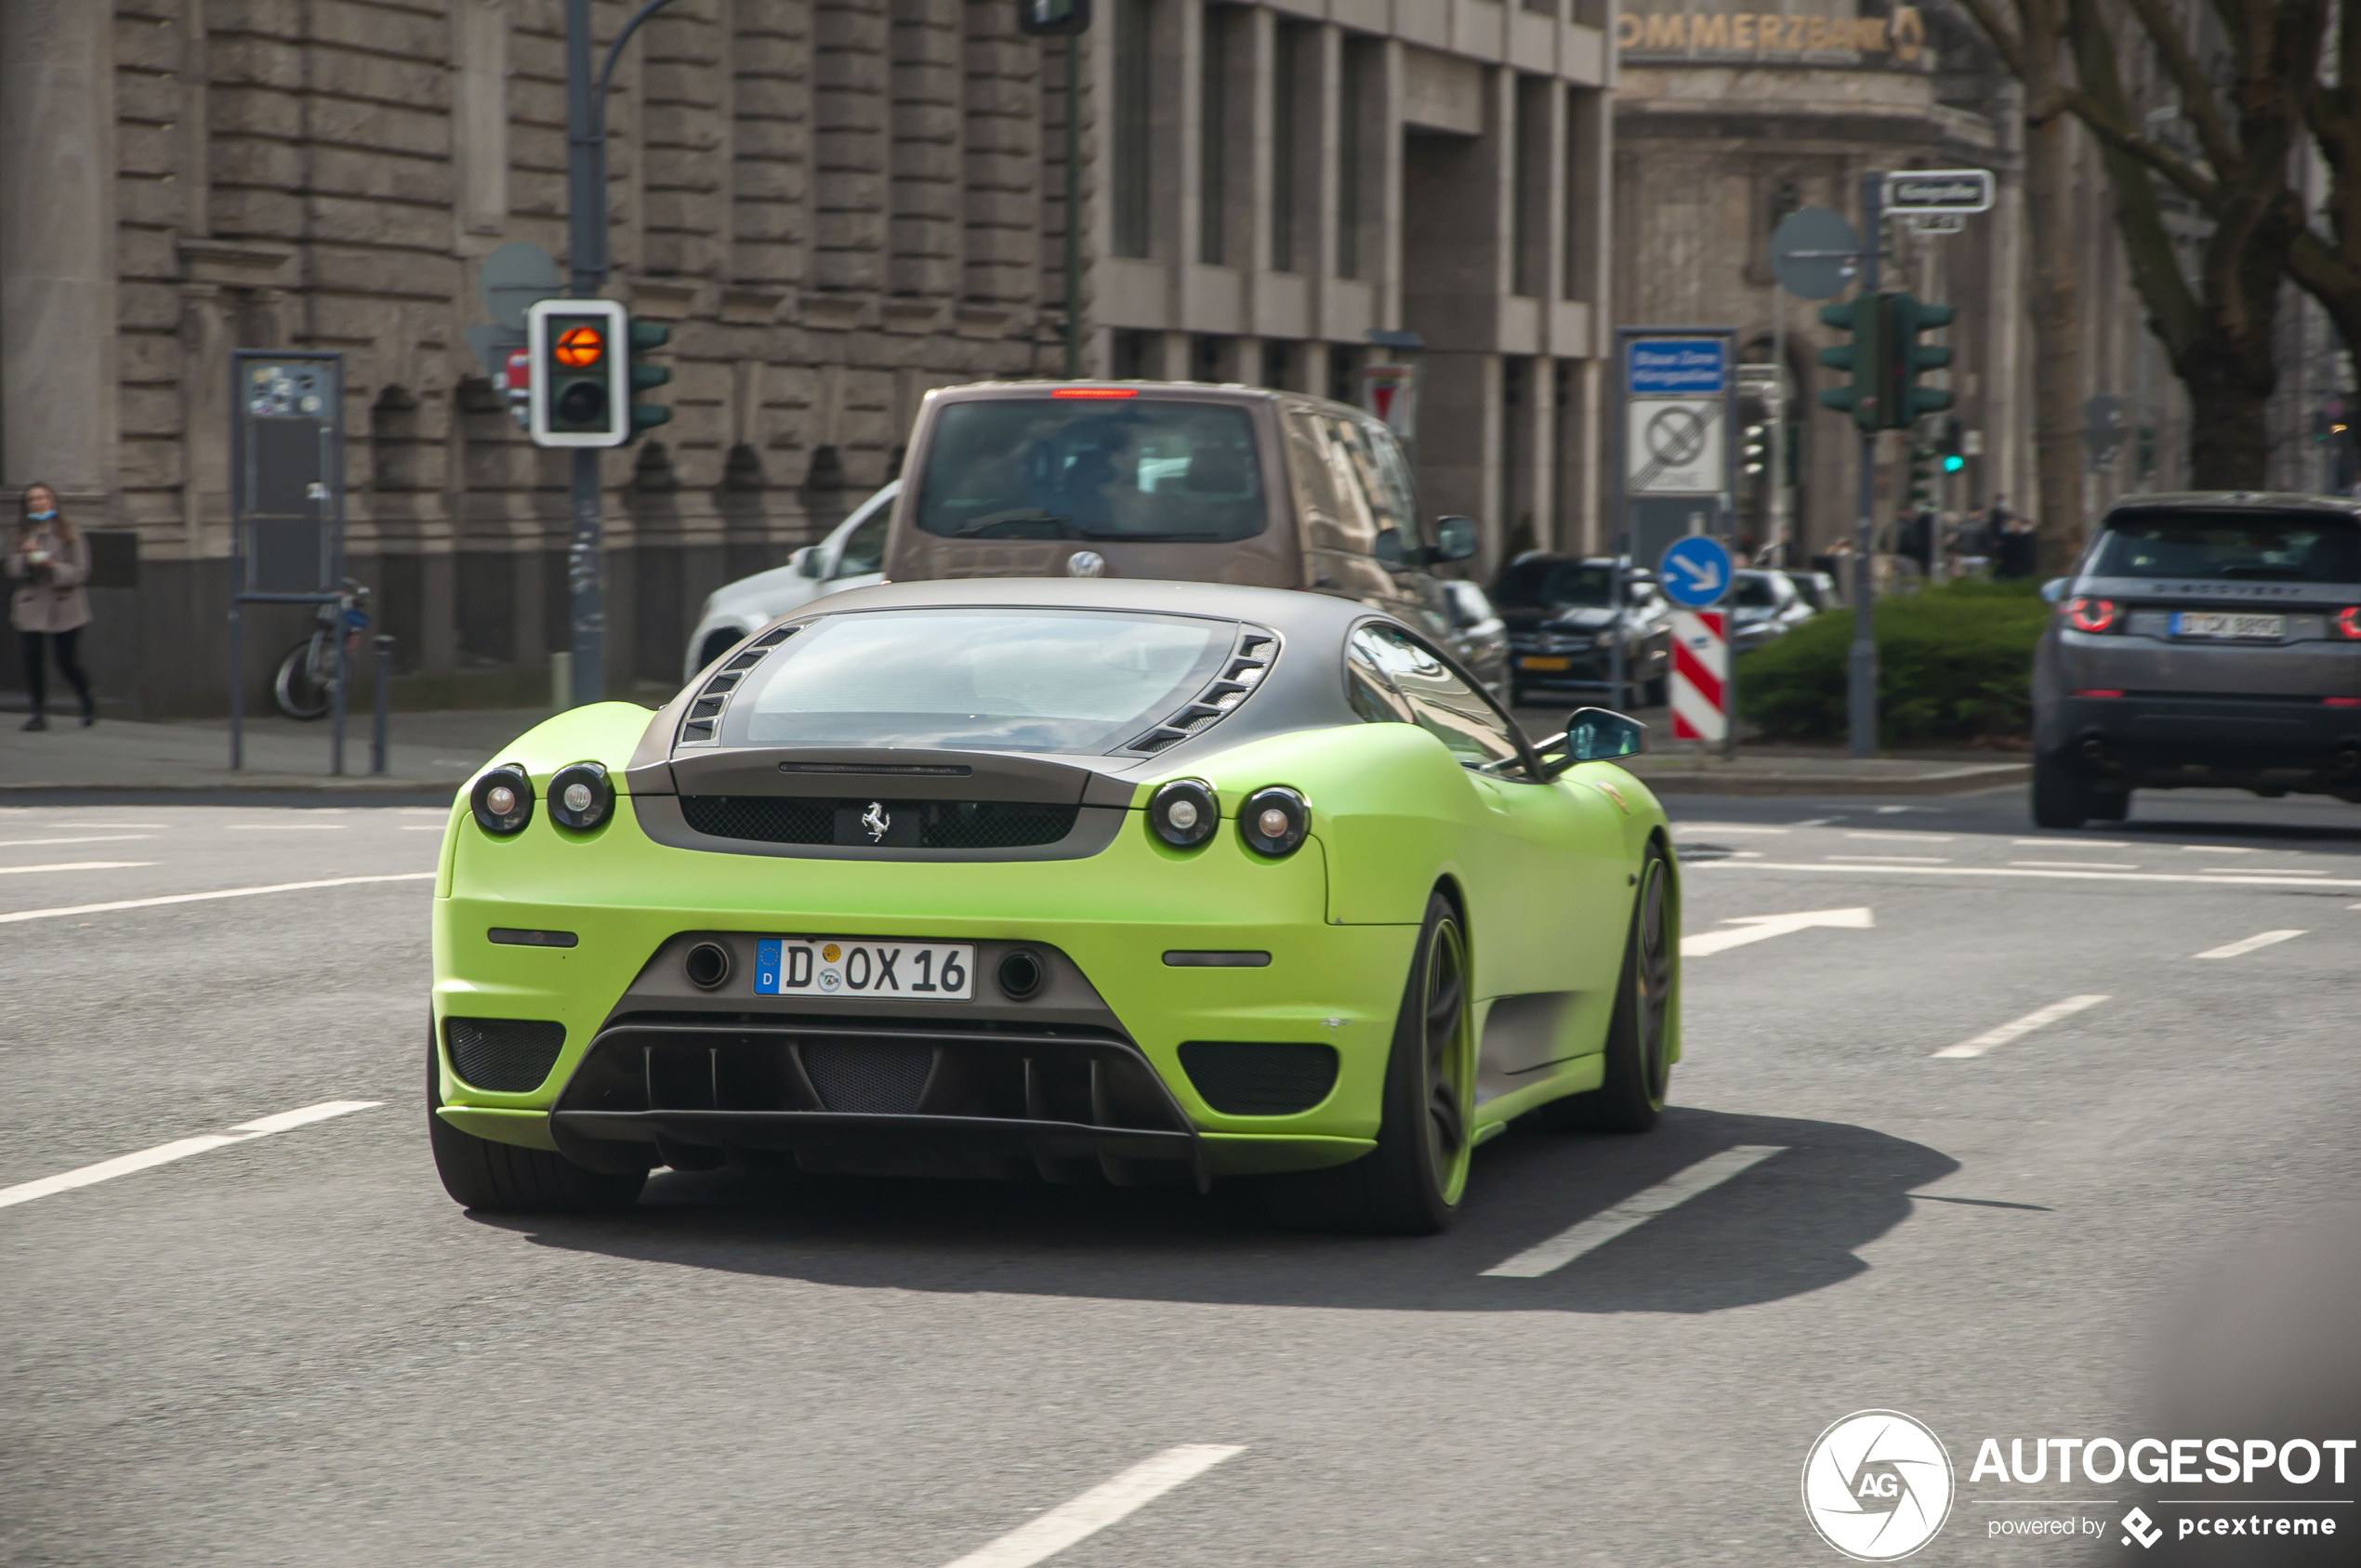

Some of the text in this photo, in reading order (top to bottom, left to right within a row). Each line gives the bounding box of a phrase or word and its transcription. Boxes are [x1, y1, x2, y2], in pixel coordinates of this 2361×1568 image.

[763, 972, 772, 985] D
[786, 946, 966, 992] D OX 16
